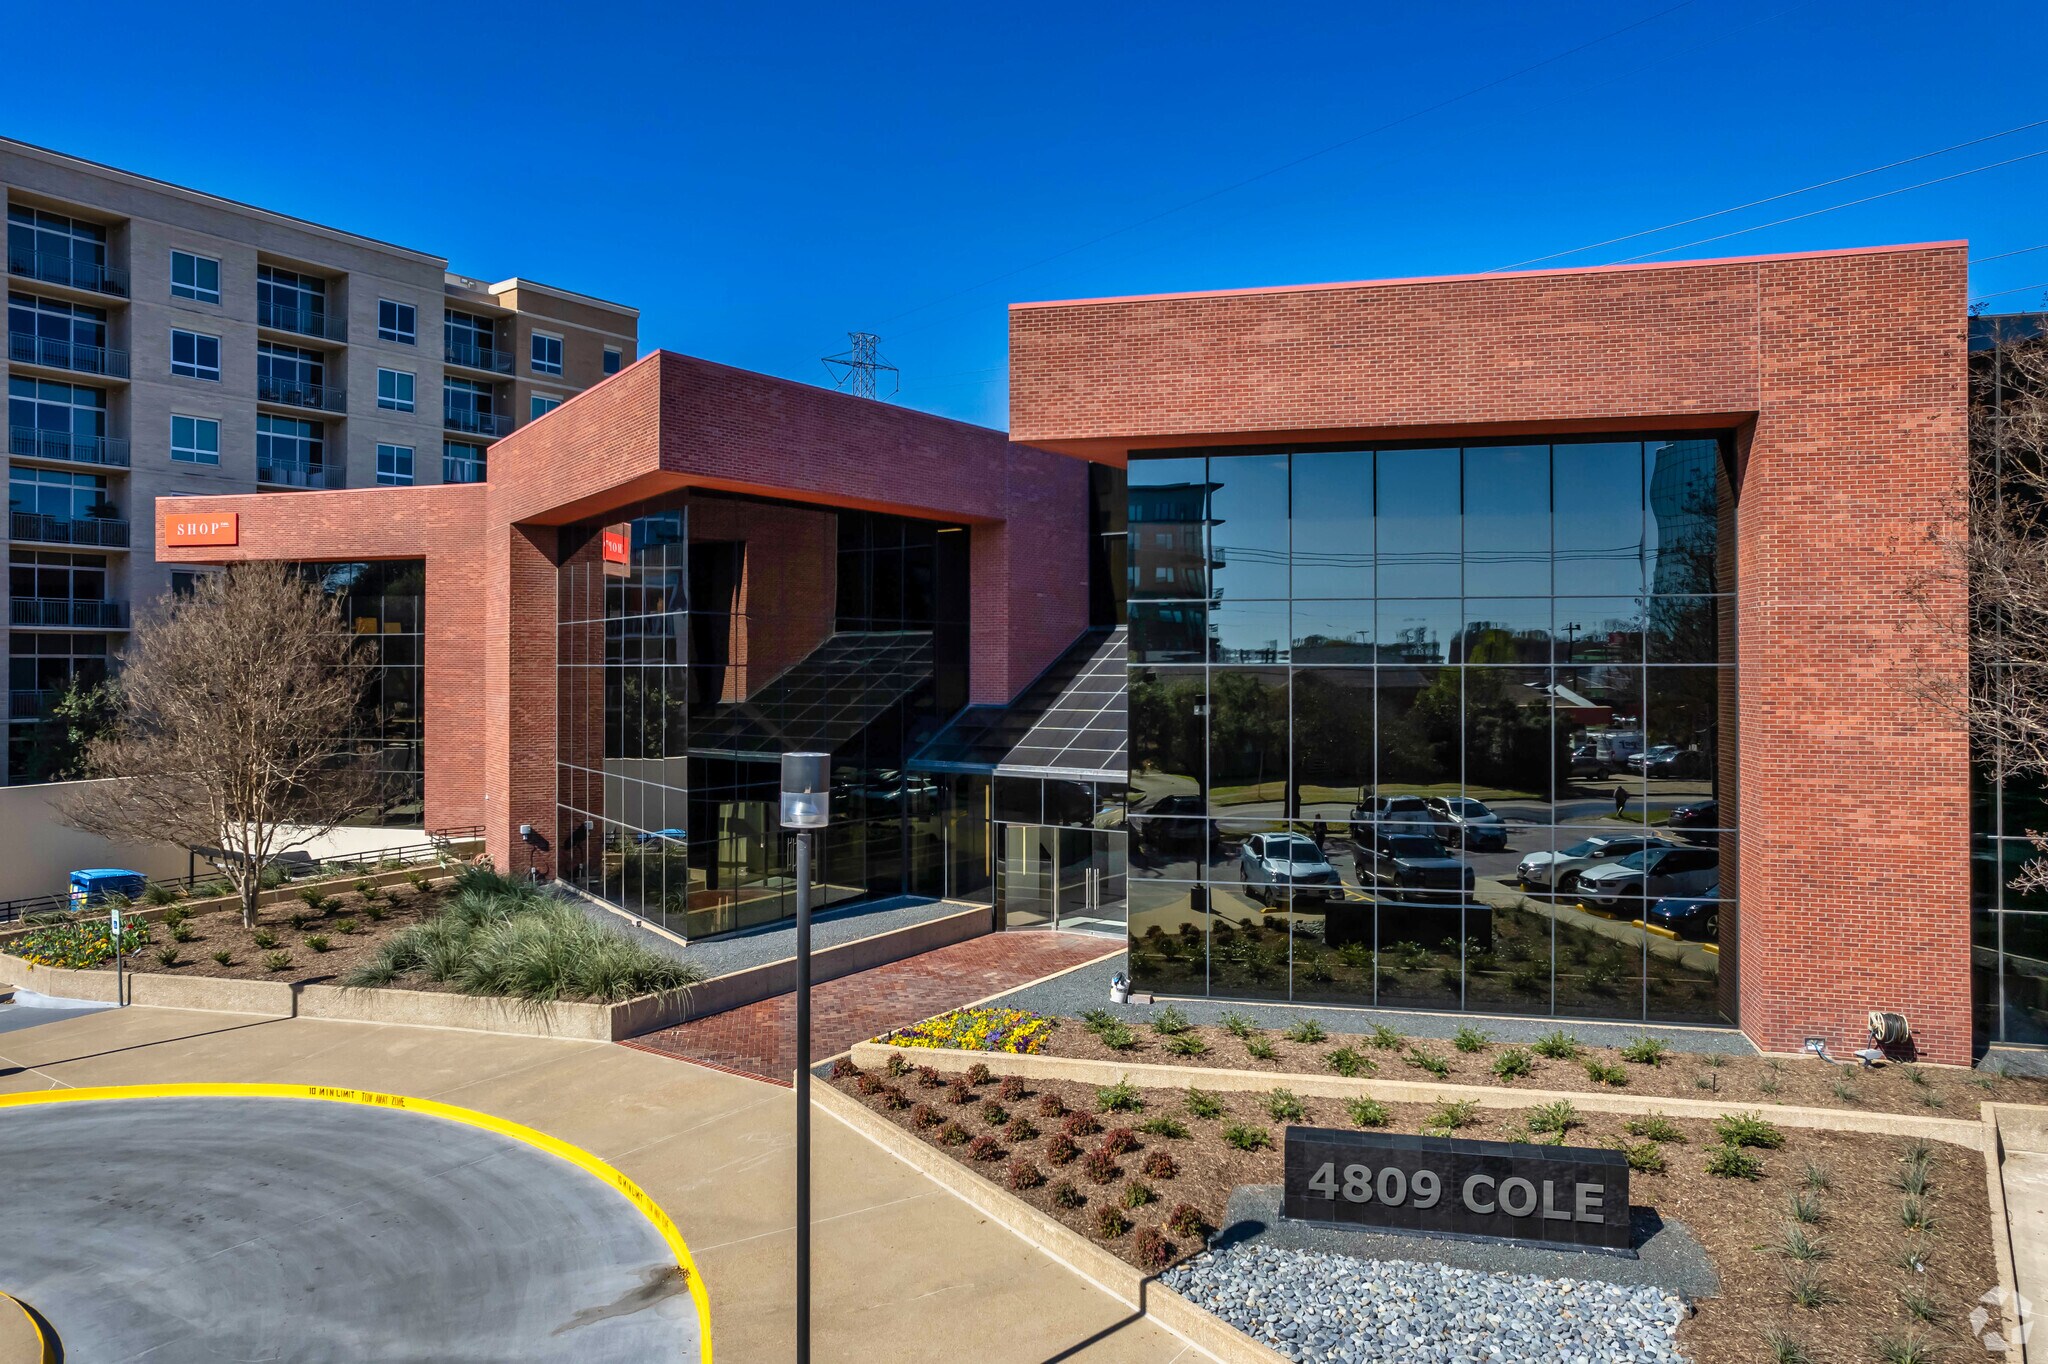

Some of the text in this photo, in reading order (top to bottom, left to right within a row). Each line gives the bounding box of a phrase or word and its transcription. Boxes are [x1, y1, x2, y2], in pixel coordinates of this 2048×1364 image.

[177, 522, 219, 536] SHOP
[319, 1088, 334, 1096] MIN
[336, 1090, 355, 1098] LIMIT
[1308, 1162, 1605, 1224] 4809 COLE
